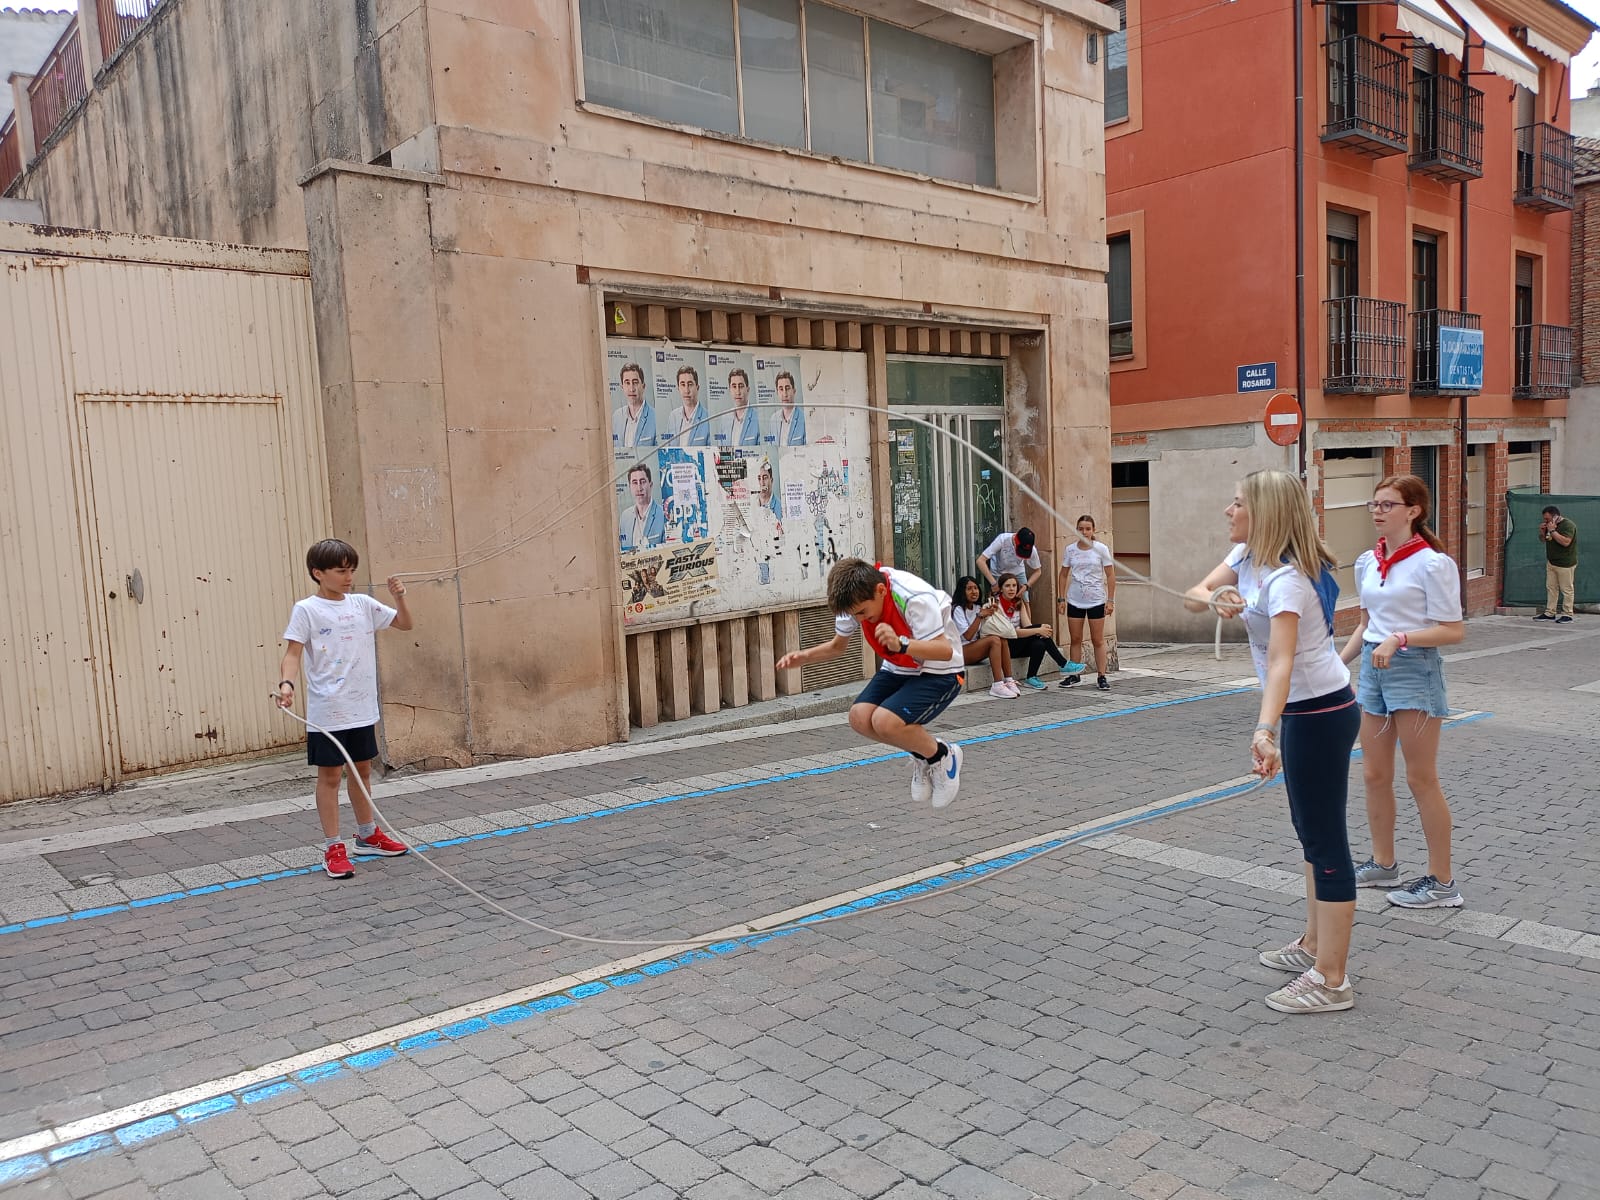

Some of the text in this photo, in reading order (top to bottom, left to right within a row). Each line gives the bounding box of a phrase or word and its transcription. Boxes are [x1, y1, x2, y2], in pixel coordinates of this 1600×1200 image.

[1246, 368, 1267, 378] CALLE
[1450, 365, 1474, 376] DENTISTA
[1242, 378, 1271, 388] ROSARIO
[665, 554, 694, 570] FAST
[670, 557, 715, 577] FURIOUS
